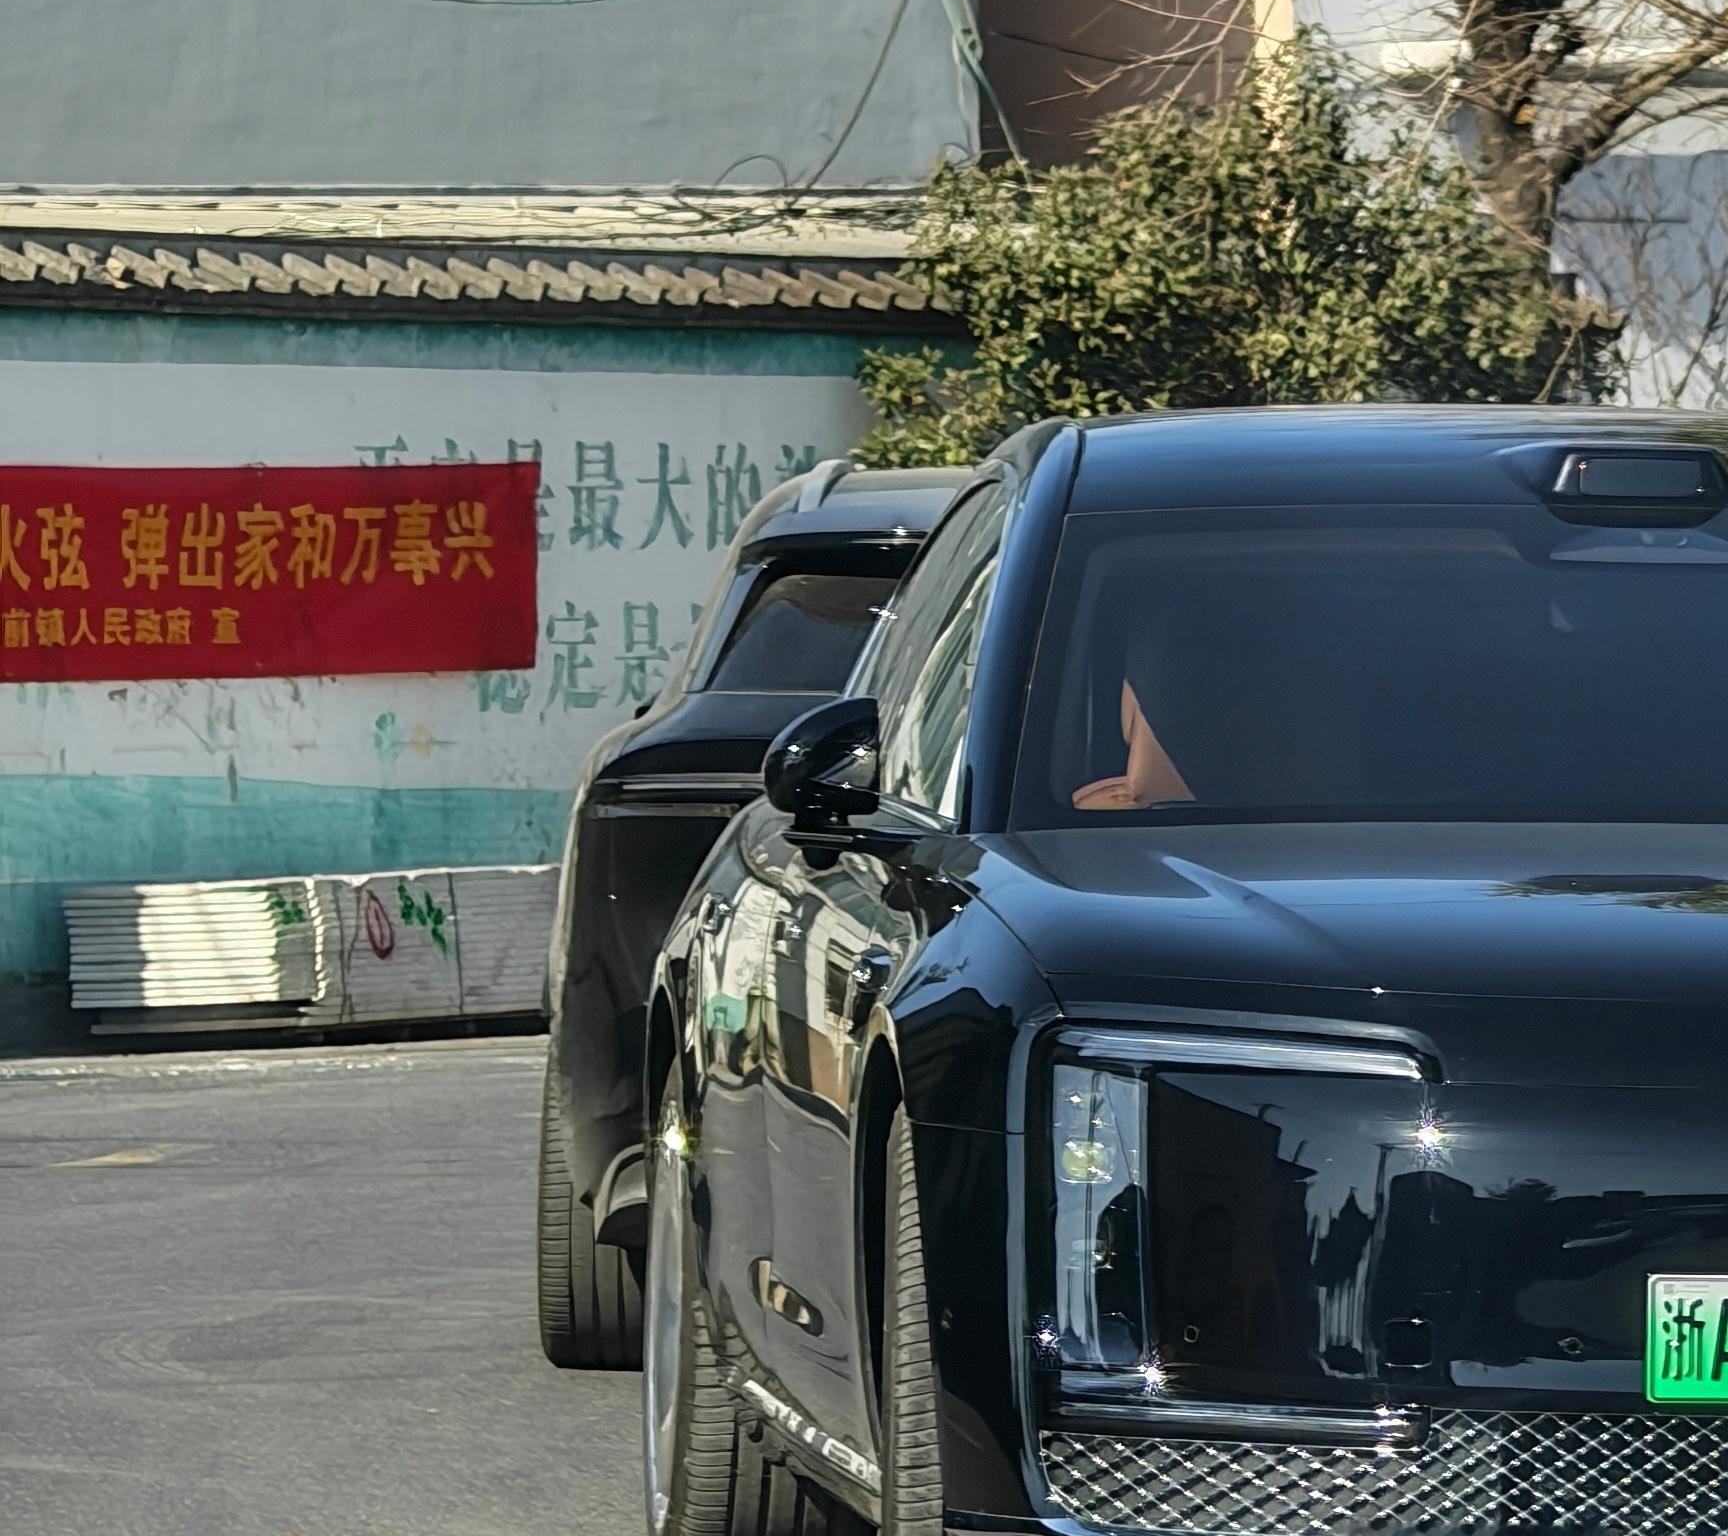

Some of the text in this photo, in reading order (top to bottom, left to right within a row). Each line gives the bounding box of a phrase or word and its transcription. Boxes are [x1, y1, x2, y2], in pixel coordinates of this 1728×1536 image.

[121, 498, 494, 590] 弹出家和万事兴
